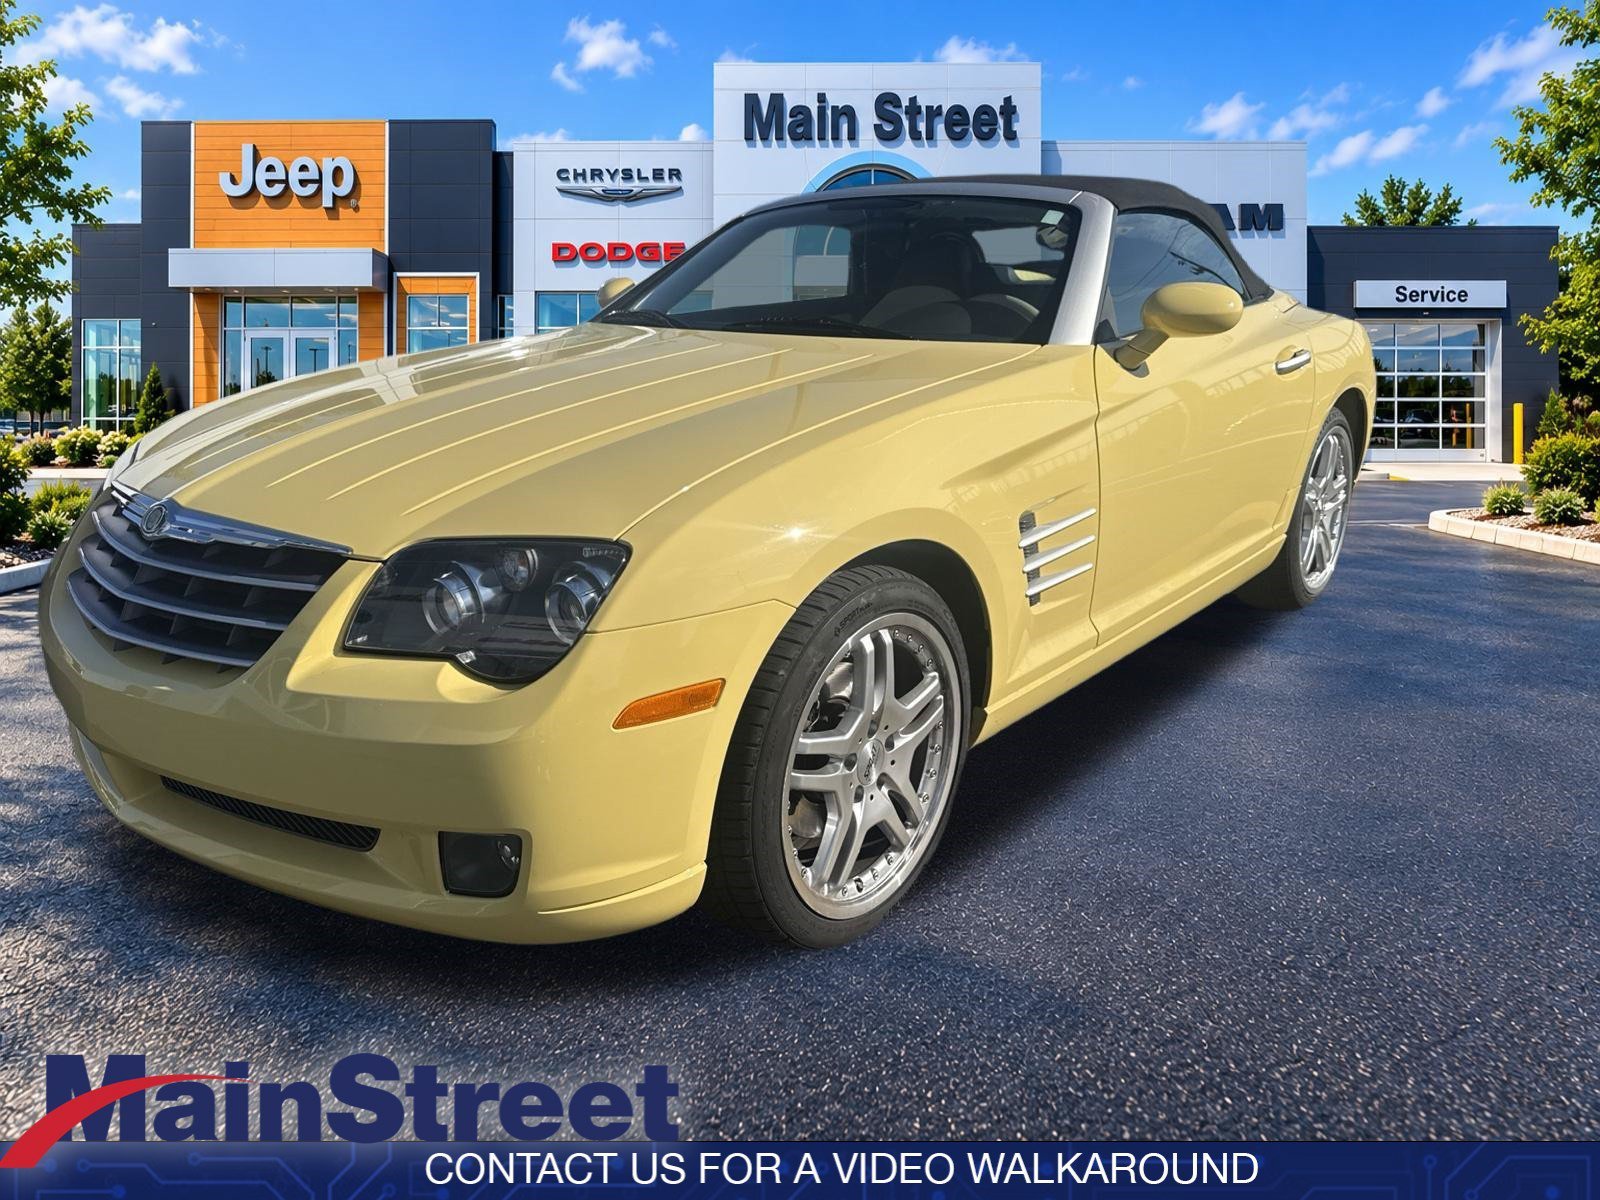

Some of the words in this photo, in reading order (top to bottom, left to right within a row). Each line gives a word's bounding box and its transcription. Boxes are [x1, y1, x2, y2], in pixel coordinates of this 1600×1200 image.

[744, 93, 857, 141] Main
[874, 92, 1018, 141] Street
[219, 143, 354, 207] Jeep
[556, 168, 682, 182] CHRYSLER
[551, 242, 685, 261] DODGE
[1395, 285, 1469, 303] Service
